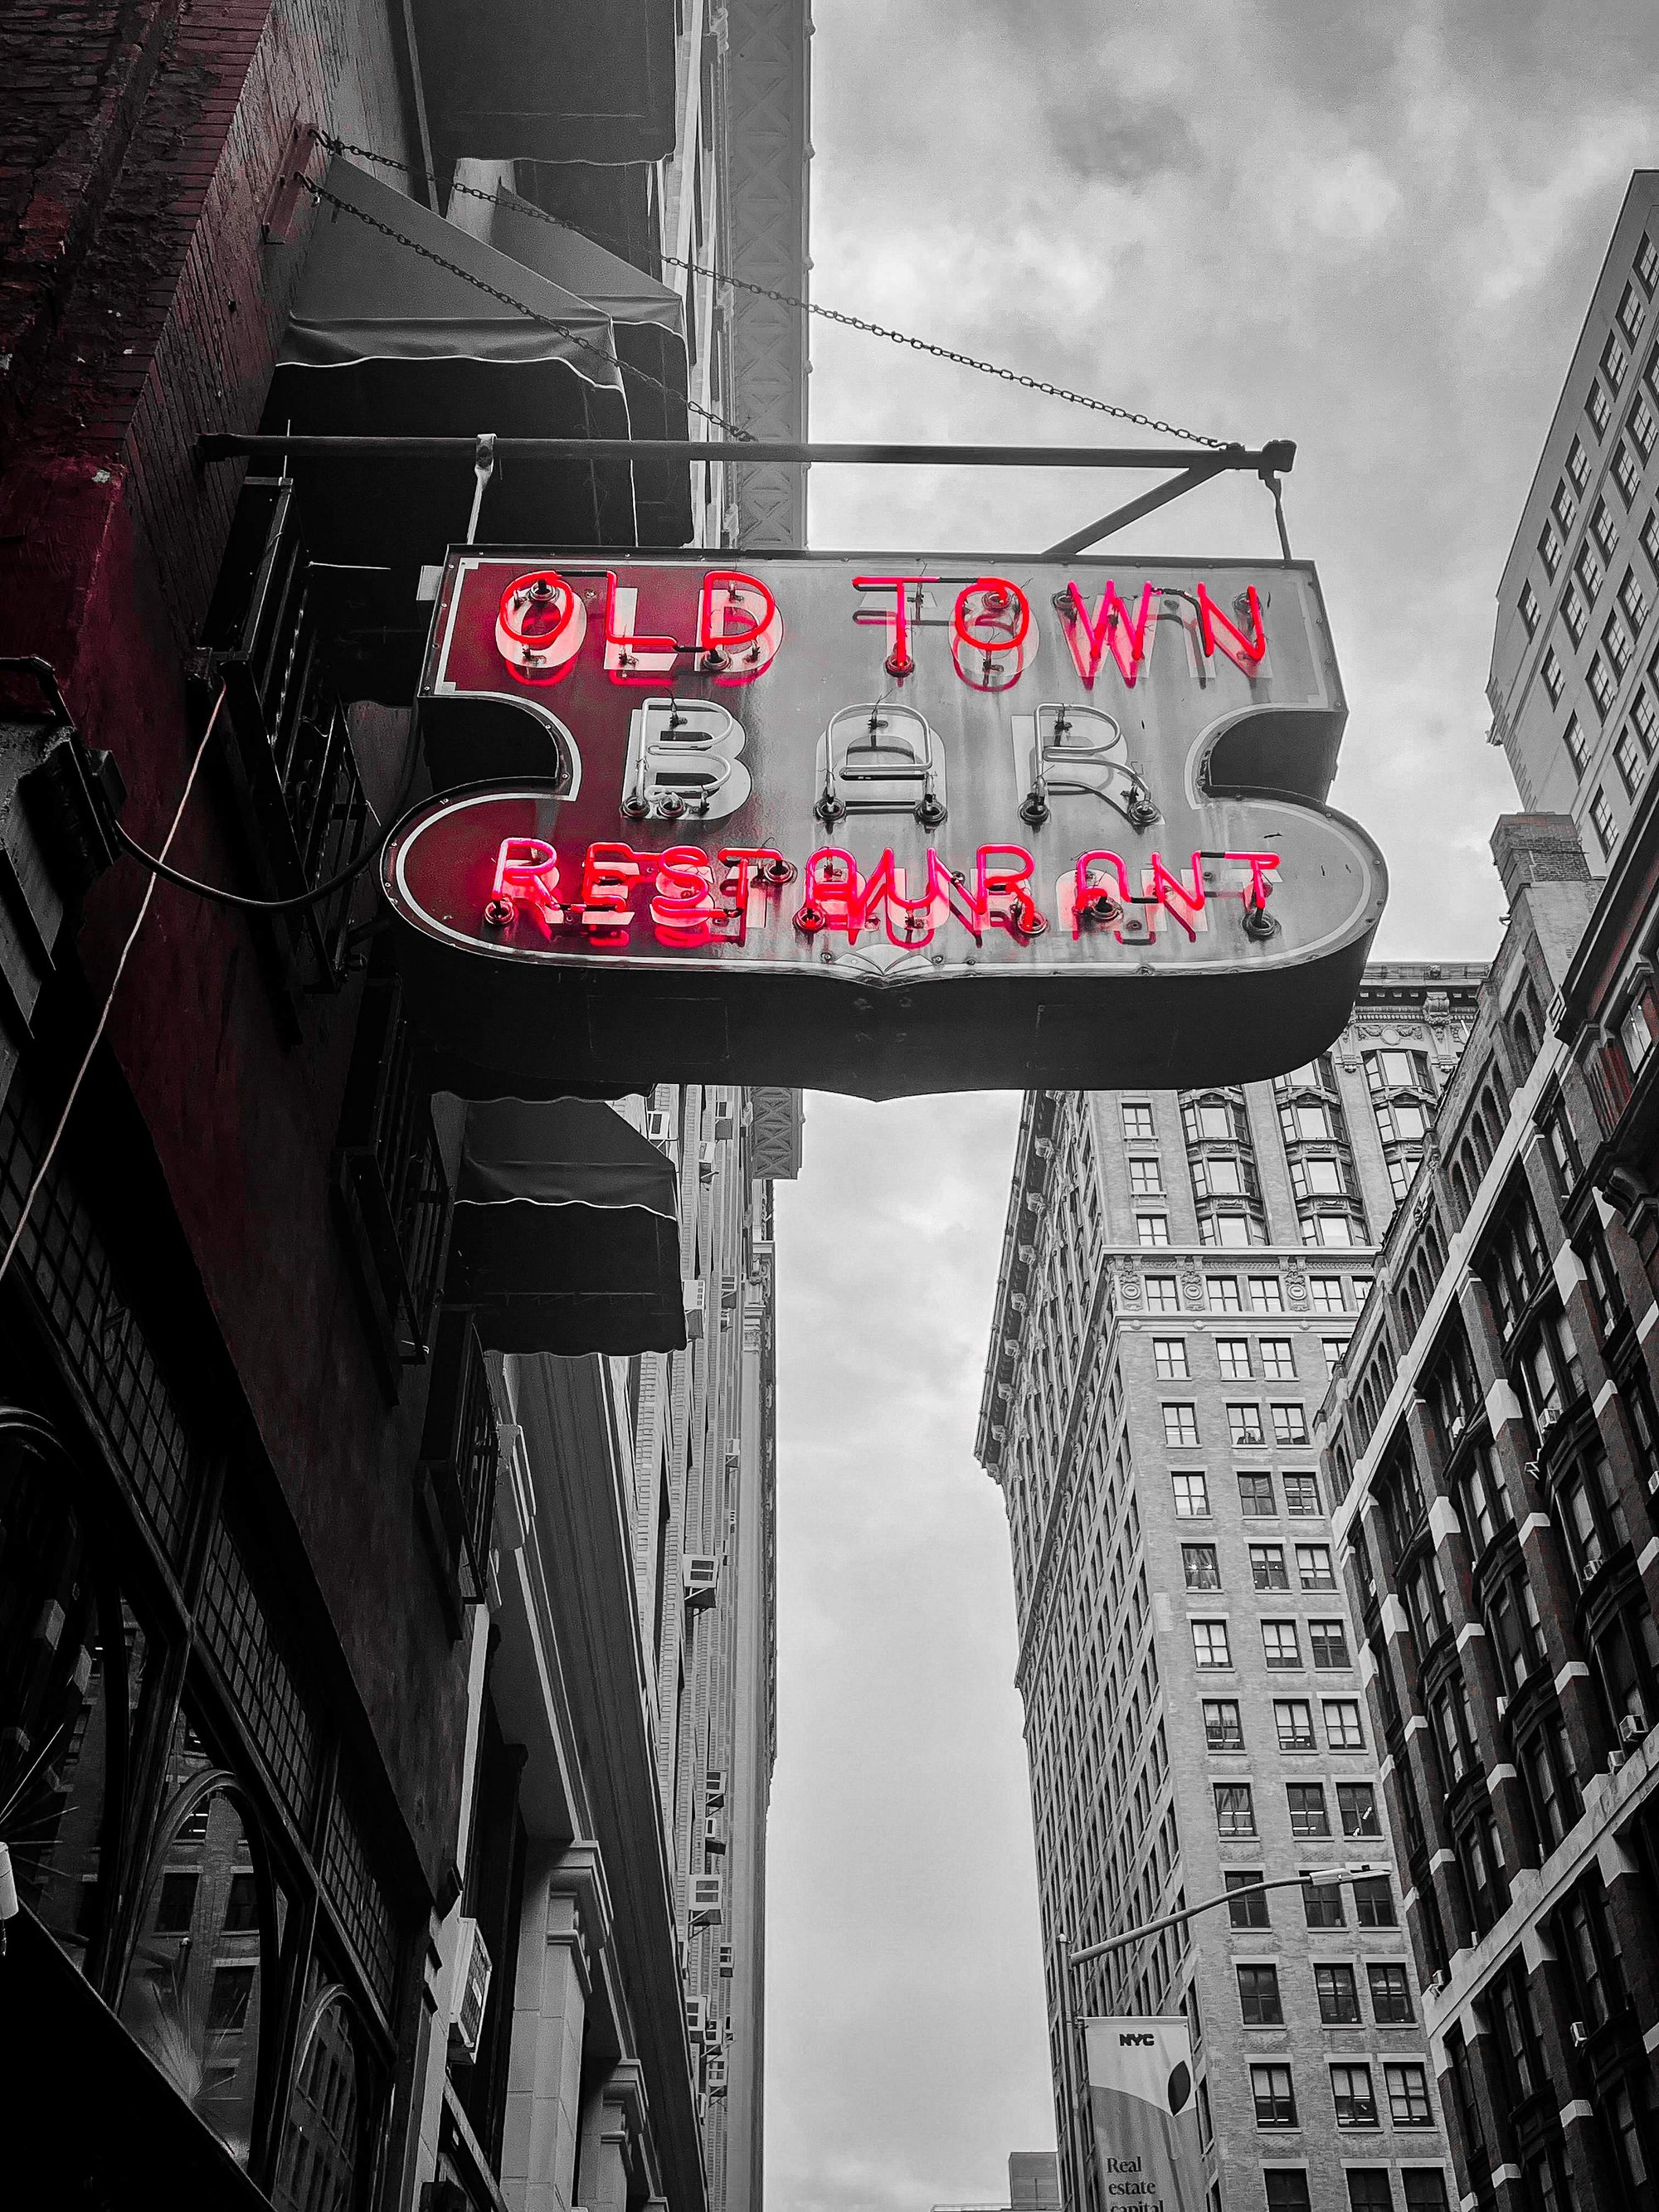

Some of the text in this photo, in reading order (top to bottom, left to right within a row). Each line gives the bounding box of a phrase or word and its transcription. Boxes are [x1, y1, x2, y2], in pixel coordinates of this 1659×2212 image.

[495, 570, 1273, 680] OLD TOWN
[620, 696, 1165, 823] BAR
[490, 837, 1282, 932] RESTAURANT
[1118, 2033, 1155, 2047] NYC
[1107, 2156, 1141, 2173] Real
[1108, 2181, 1156, 2195] estate
